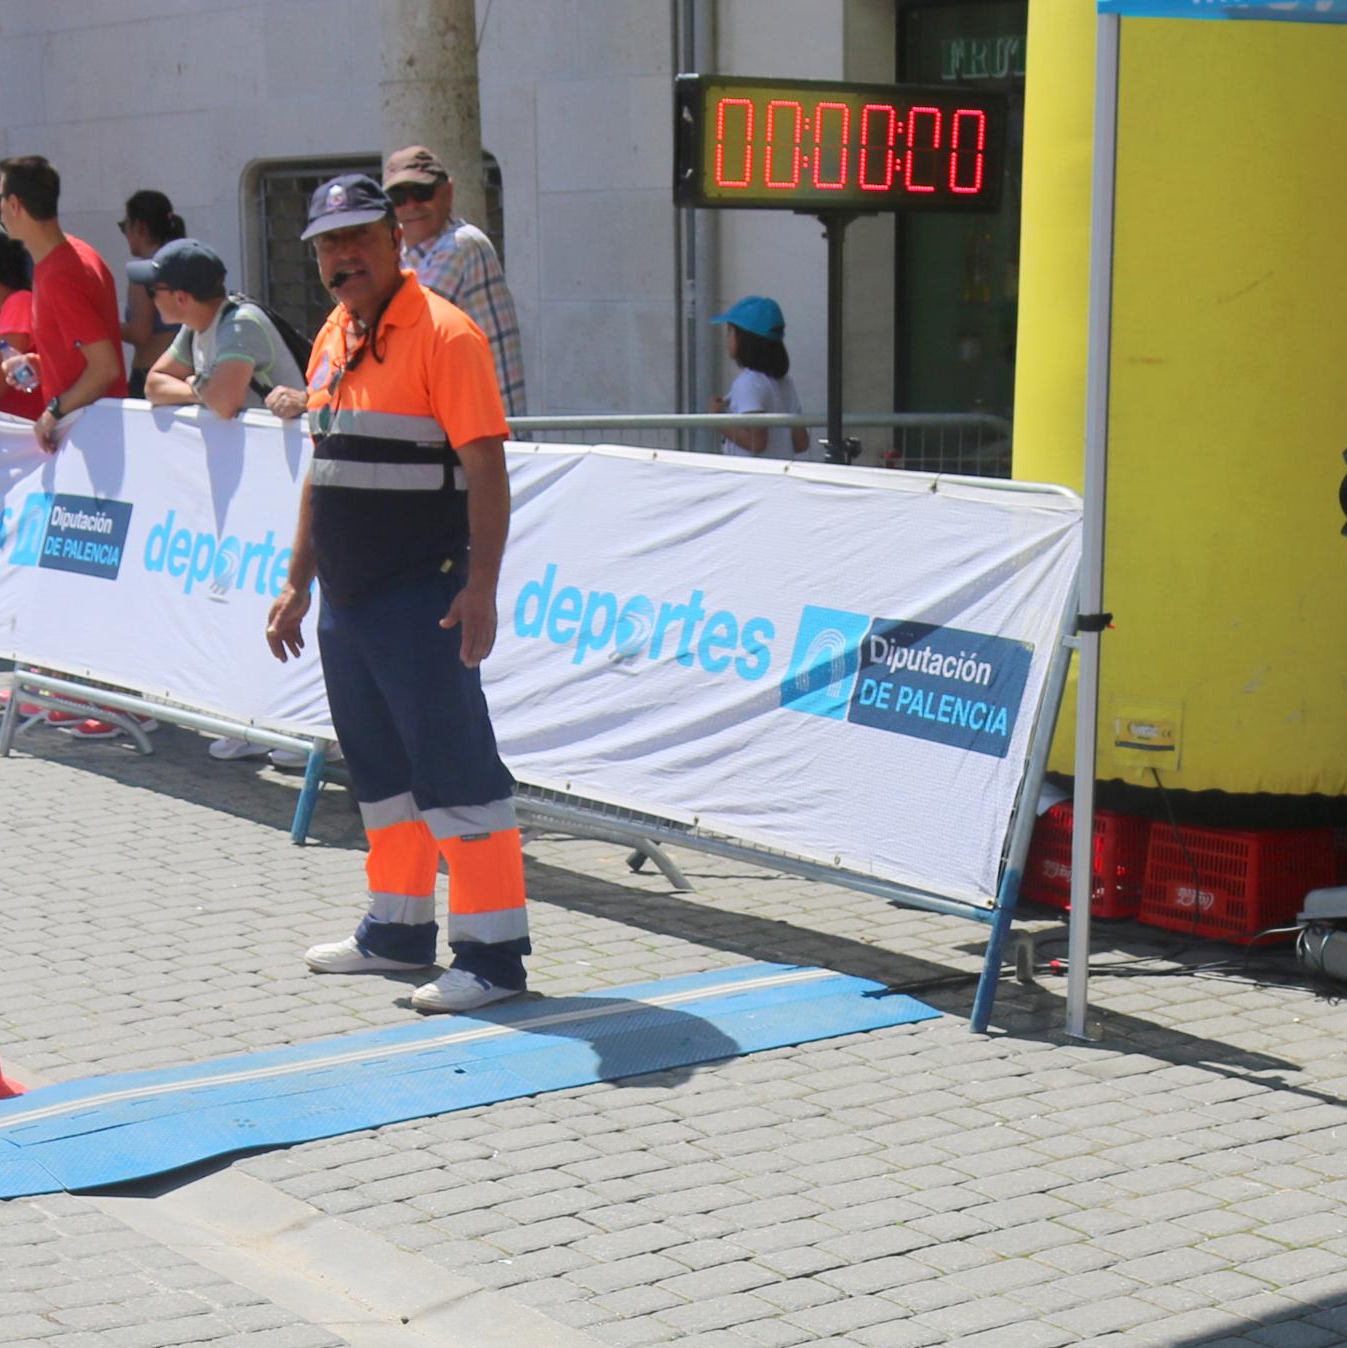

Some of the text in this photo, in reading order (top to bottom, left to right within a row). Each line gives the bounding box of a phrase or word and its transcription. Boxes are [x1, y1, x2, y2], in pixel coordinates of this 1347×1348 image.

[51, 505, 114, 535] Diputación
[44, 535, 121, 568] DE PALENCIA
[143, 509, 315, 598] deporte
[513, 562, 776, 682] deportes
[868, 634, 993, 687] Diputación
[859, 680, 1009, 737] DE PALENCIA
